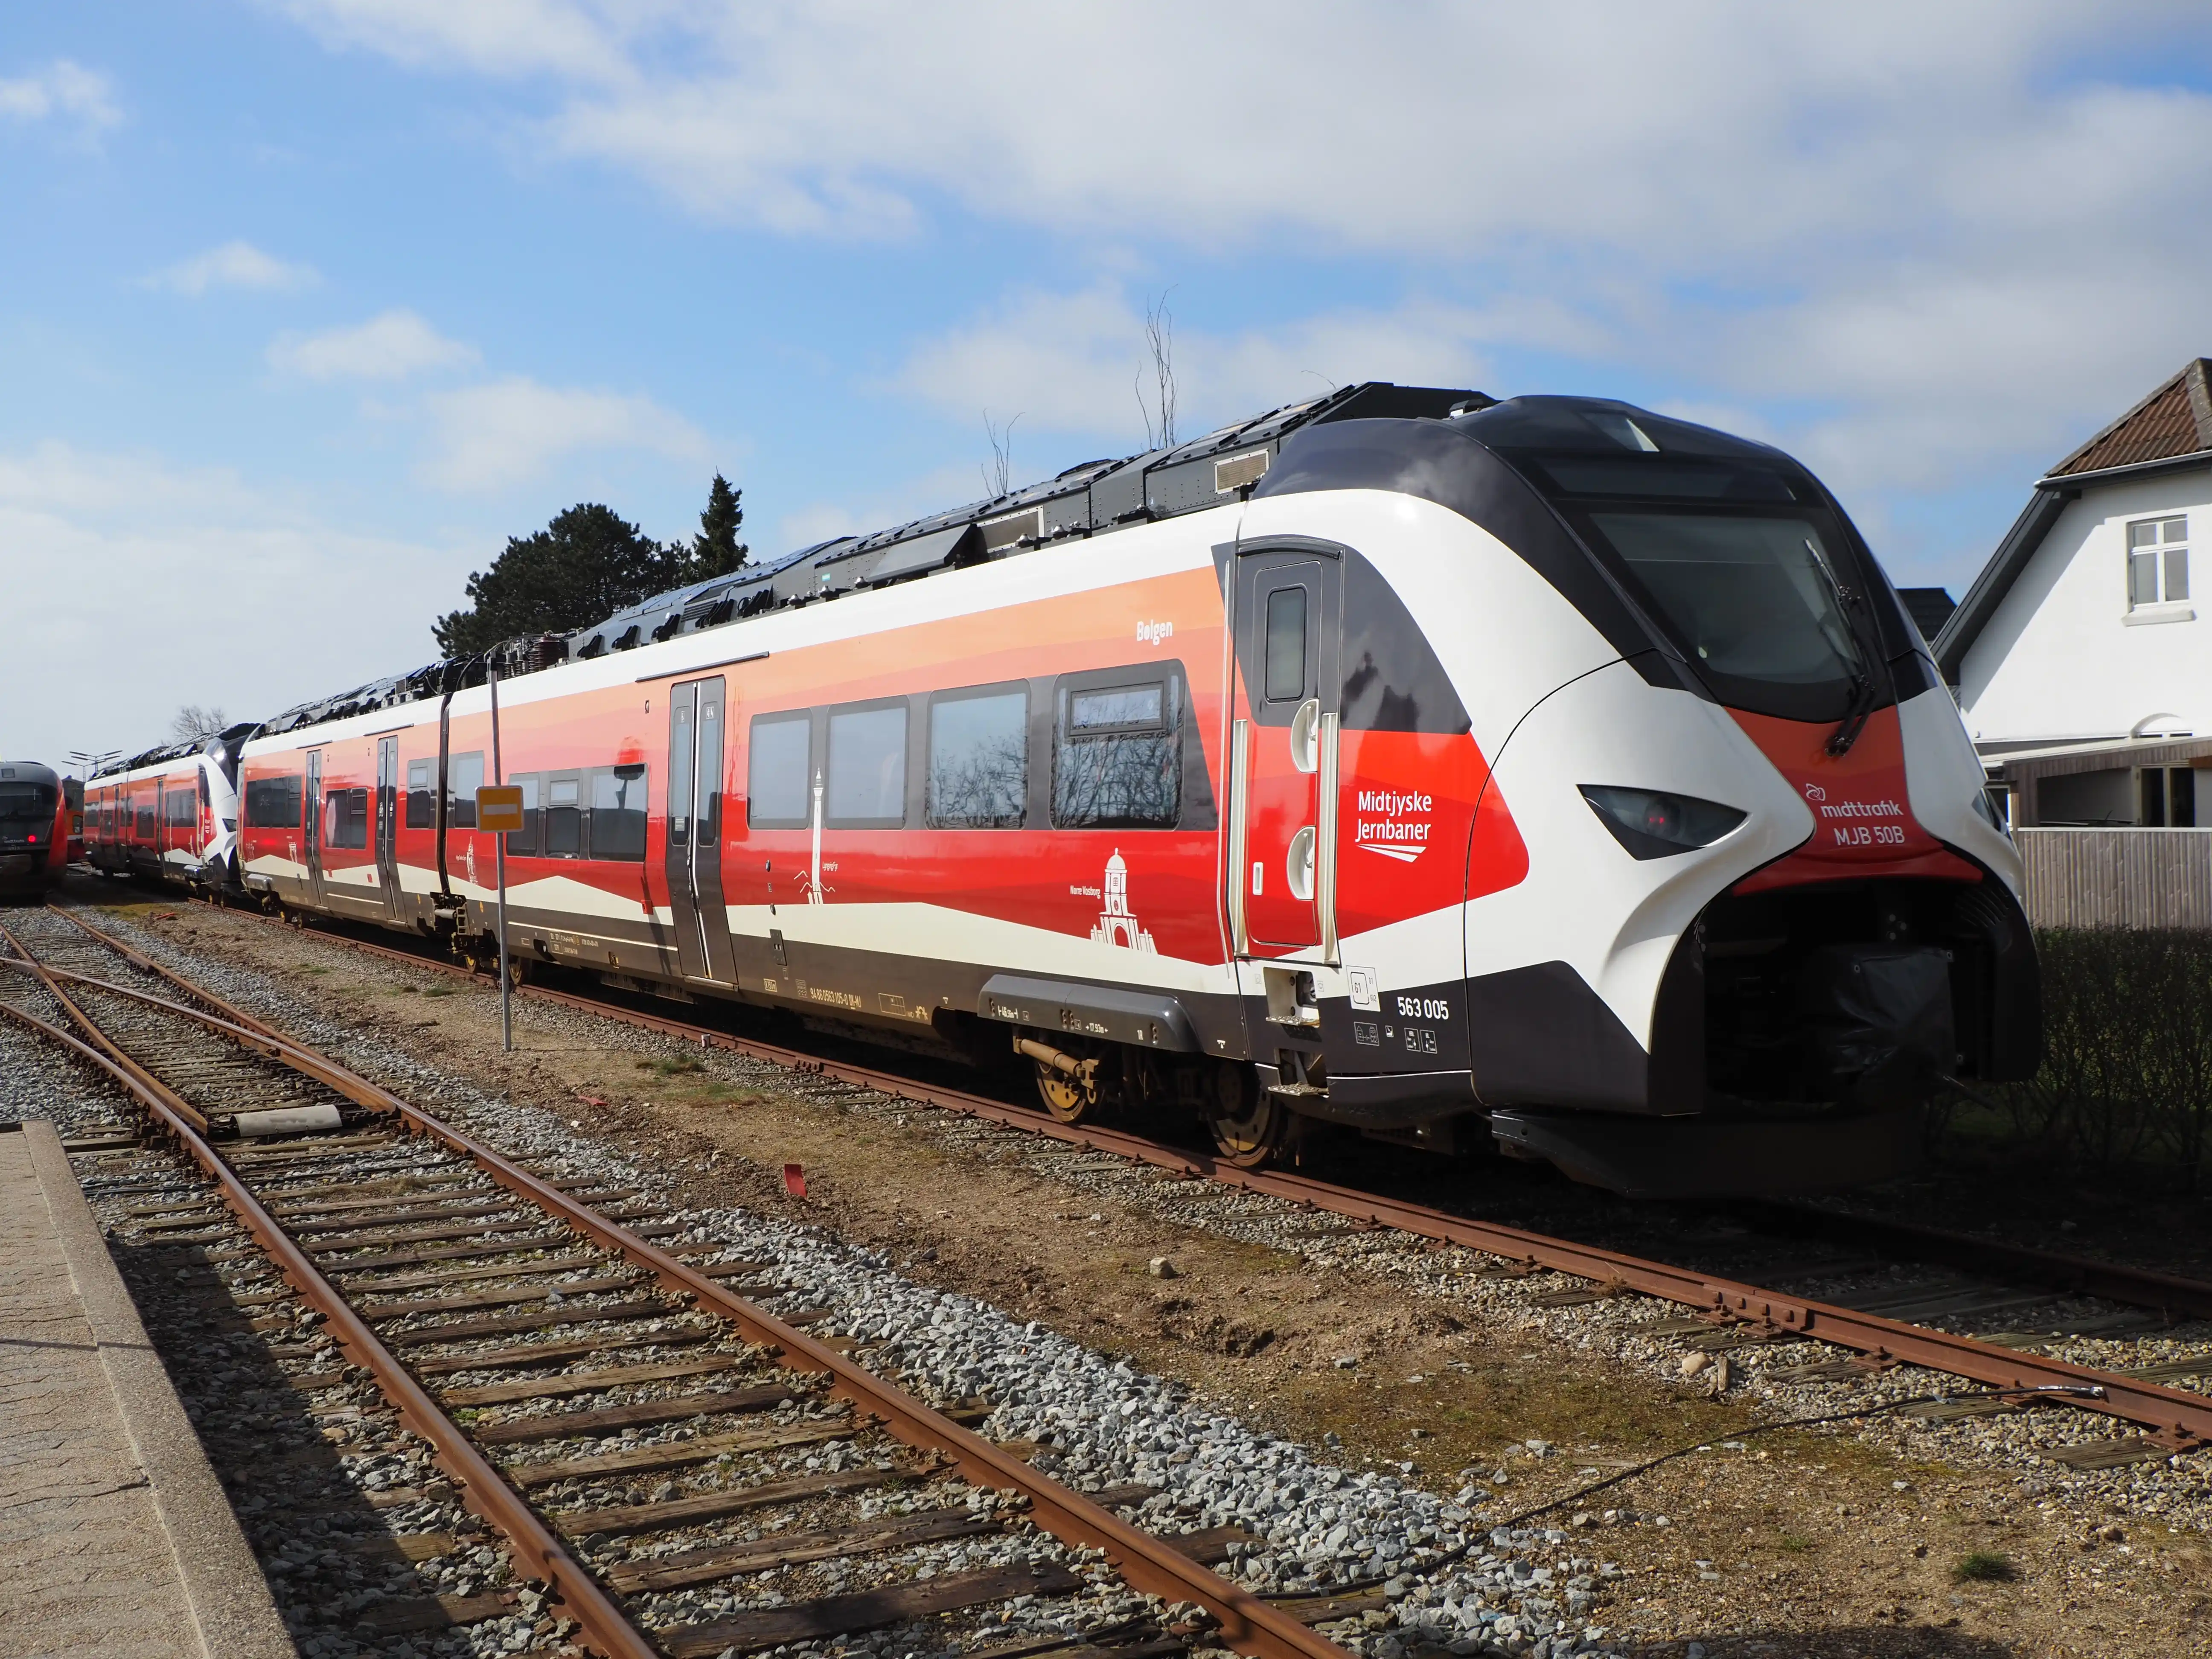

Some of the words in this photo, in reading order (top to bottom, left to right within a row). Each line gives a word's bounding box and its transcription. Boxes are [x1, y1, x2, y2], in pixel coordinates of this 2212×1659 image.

[1359, 791, 1432, 816] Midtjyske
[1820, 800, 1904, 817] midttrafik
[1355, 818, 1431, 842] Jernbaner
[1834, 827, 1871, 845] MJB
[1873, 826, 1905, 844] 50B
[1082, 886, 1101, 899] Vosborg
[810, 987, 817, 999] 94
[816, 988, 823, 1001] 86
[822, 990, 835, 1003] 0563
[835, 992, 848, 1006] 105-0
[1397, 996, 1422, 1017] 563
[1424, 999, 1449, 1020] 005
